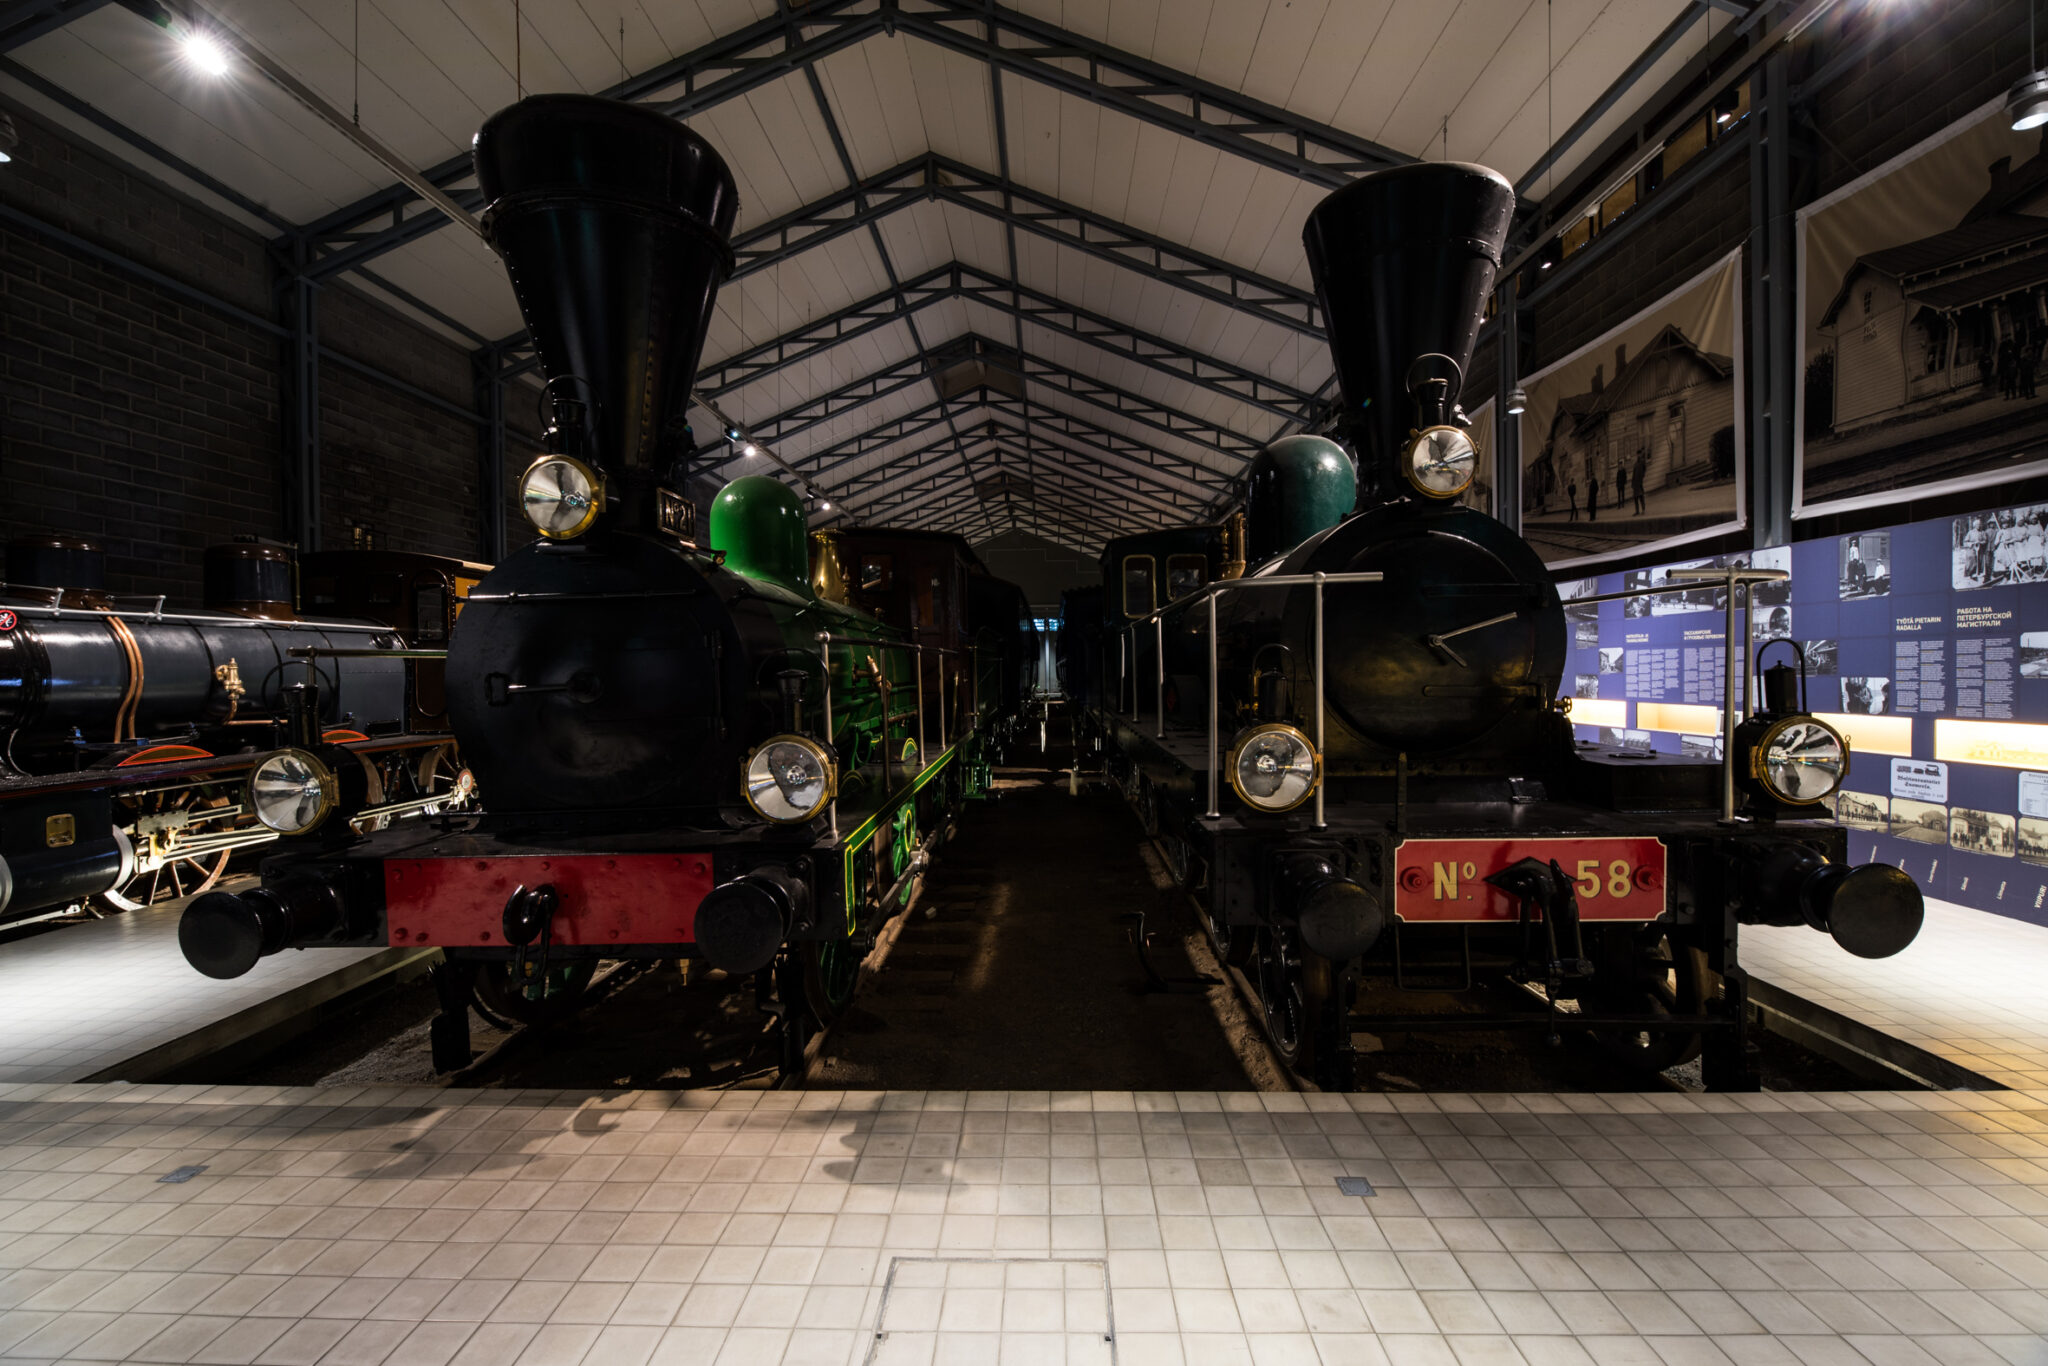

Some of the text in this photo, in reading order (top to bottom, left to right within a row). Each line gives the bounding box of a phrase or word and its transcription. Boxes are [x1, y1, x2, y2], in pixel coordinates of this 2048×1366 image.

[1957, 612, 2012, 621] ПЕТЕРБУРГСКОЙ
[1957, 620, 2000, 628] МАГИСТРАЛИ
[1576, 859, 1632, 898] 58
[2034, 885, 2047, 908] VIIPURI
